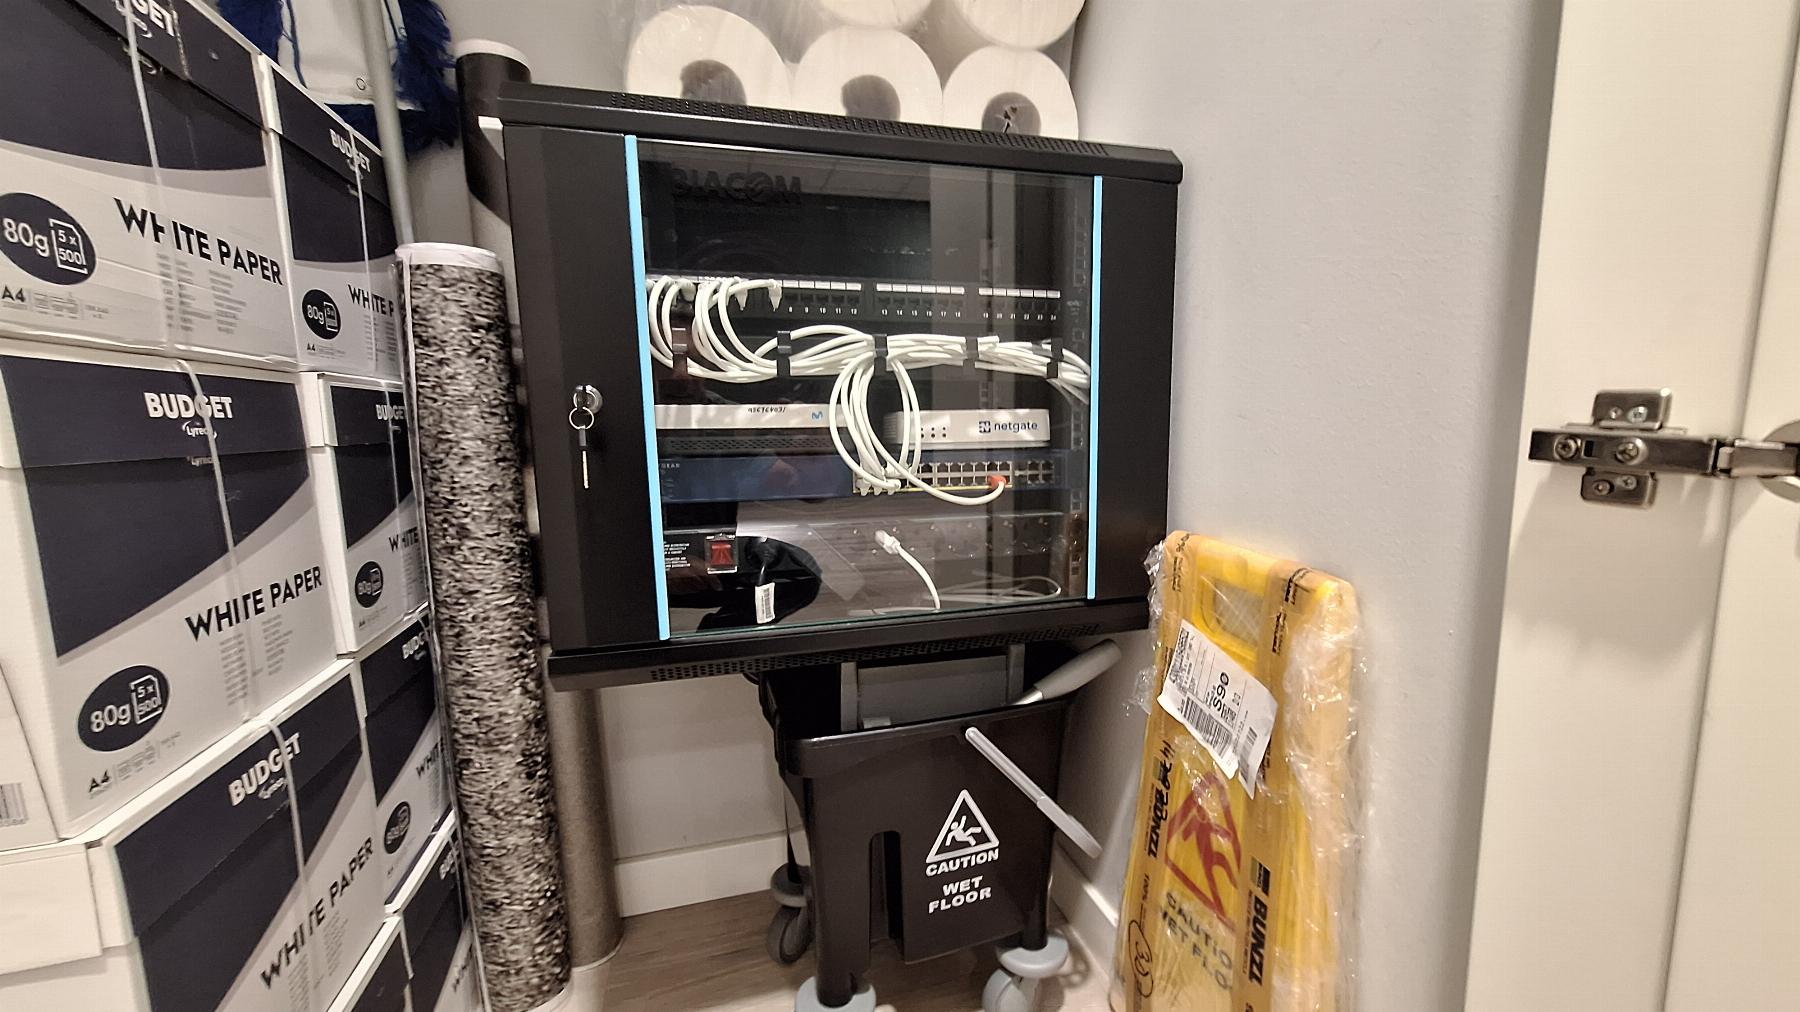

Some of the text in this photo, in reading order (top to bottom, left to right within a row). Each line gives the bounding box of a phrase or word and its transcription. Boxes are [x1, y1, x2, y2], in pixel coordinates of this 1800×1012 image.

[3, 218, 50, 257] 80g
[58, 229, 67, 243] 5
[58, 247, 83, 265] 500
[216, 238, 283, 286] PAPER
[2, 284, 26, 303] A4
[143, 392, 233, 419] BUDGET
[994, 421, 1038, 433] netgate
[184, 565, 322, 643] WHITE PAPER
[137, 686, 146, 698] 5
[90, 704, 132, 733] 80g
[89, 769, 110, 793] A4
[228, 732, 301, 807] BUDGET
[926, 848, 999, 877] CAUTION
[942, 875, 983, 897] WET
[260, 898, 326, 990] WHITE
[329, 836, 373, 909] PAPER
[928, 887, 992, 914] FLOOR
[1248, 895, 1269, 986] BUNZL
